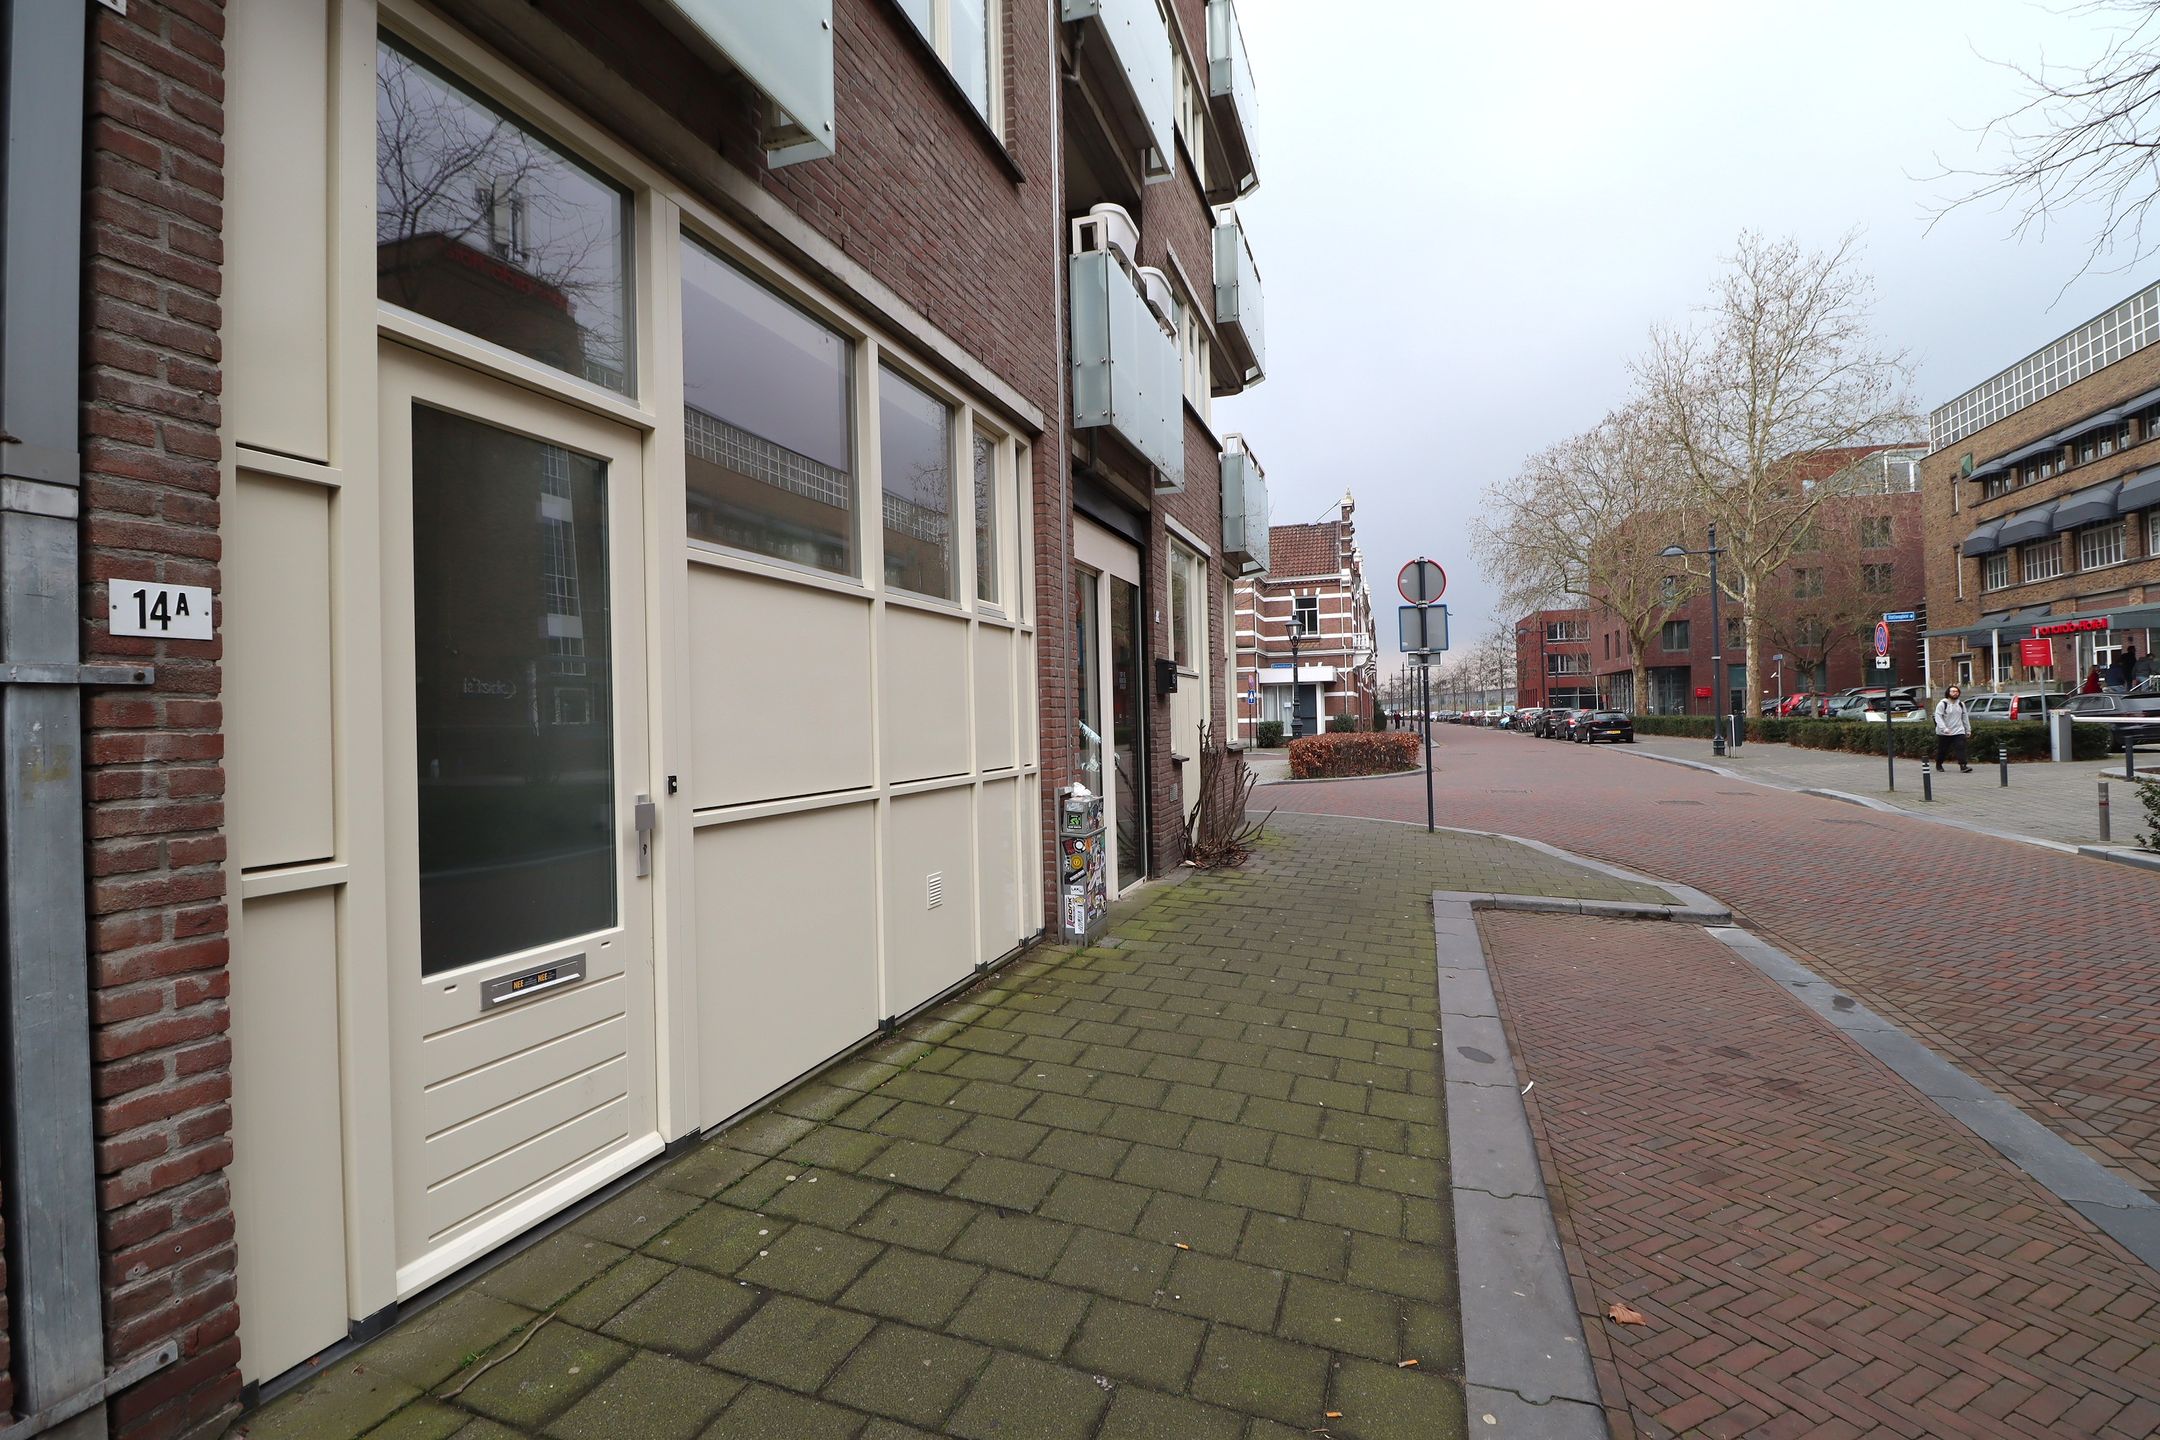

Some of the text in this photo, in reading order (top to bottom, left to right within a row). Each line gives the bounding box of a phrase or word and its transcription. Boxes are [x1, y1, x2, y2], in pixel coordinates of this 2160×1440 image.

[133, 589, 190, 631] 14A
[537, 972, 548, 982] NEE
[513, 979, 524, 989] NEE
